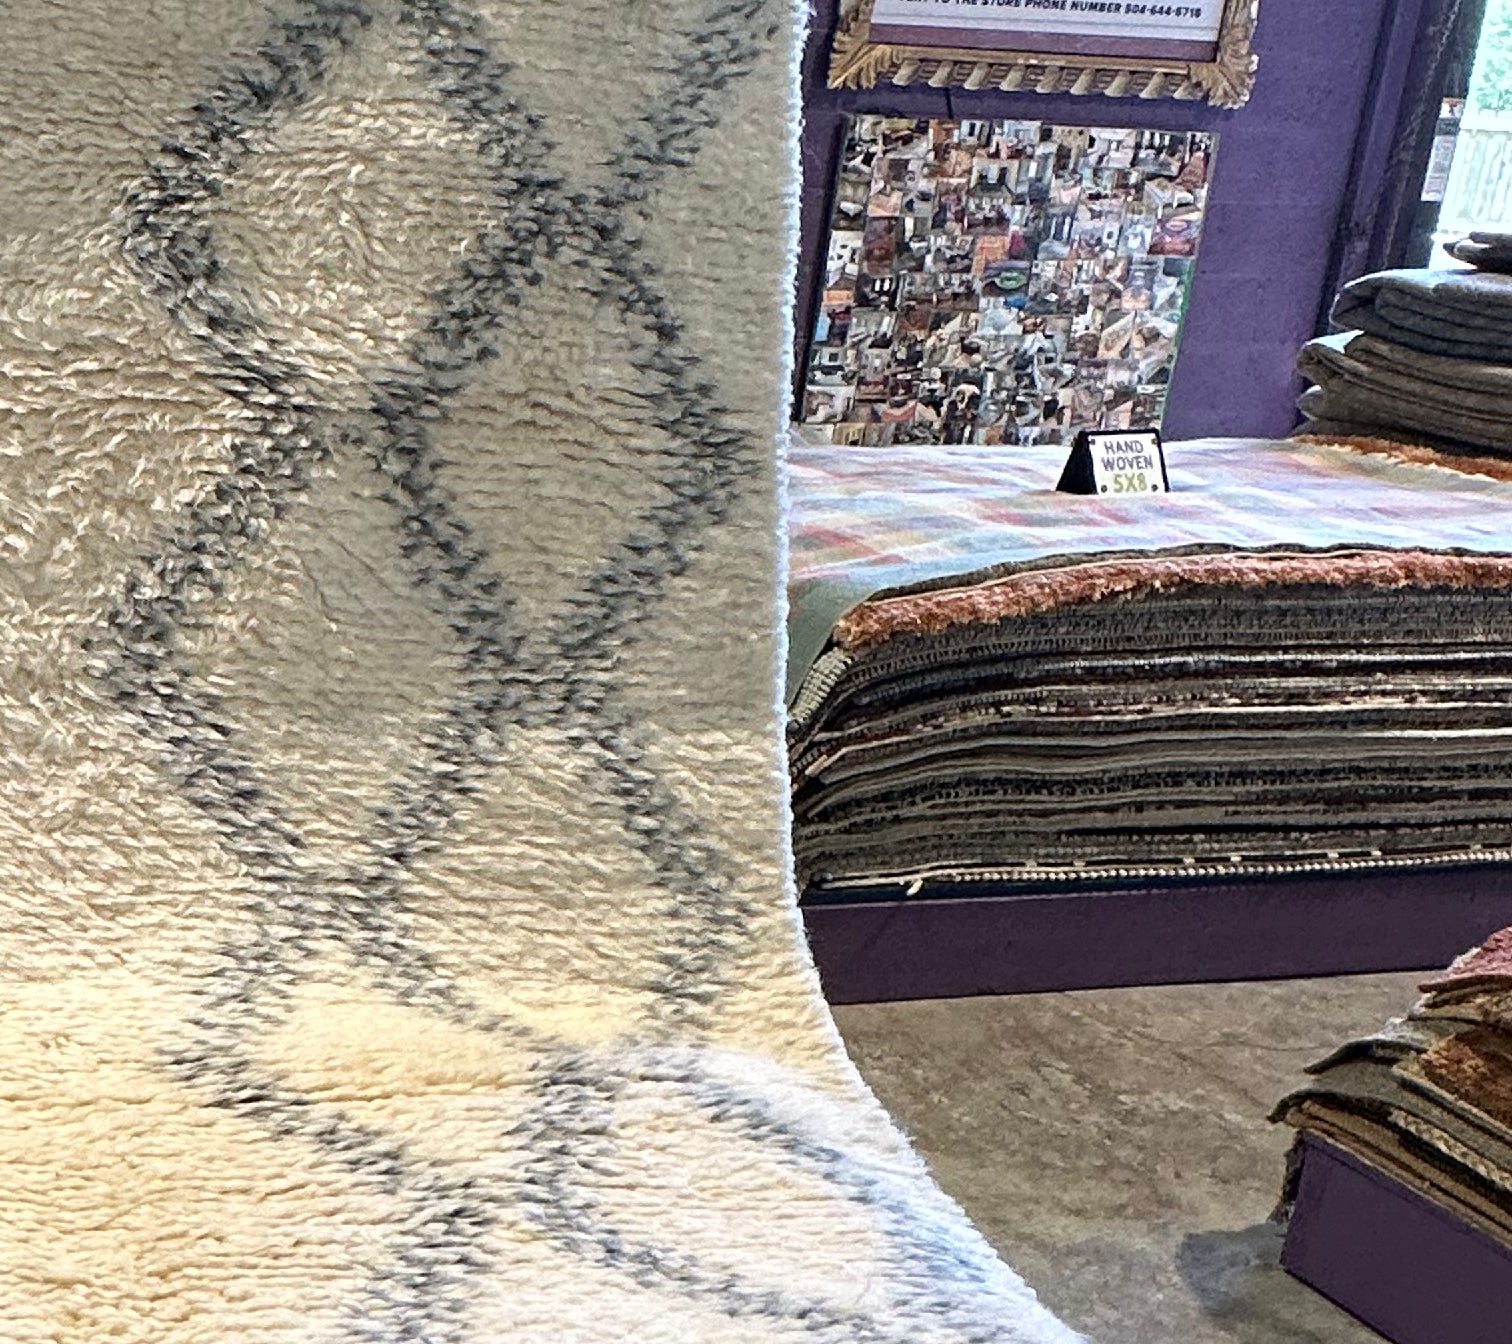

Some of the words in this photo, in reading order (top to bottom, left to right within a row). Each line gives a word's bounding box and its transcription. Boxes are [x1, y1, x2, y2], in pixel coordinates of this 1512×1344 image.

[1070, 0, 1122, 14] NUMBER
[1103, 439, 1144, 455] HAND
[1101, 455, 1154, 472] WOVEN
[1112, 472, 1148, 493] 5X8
